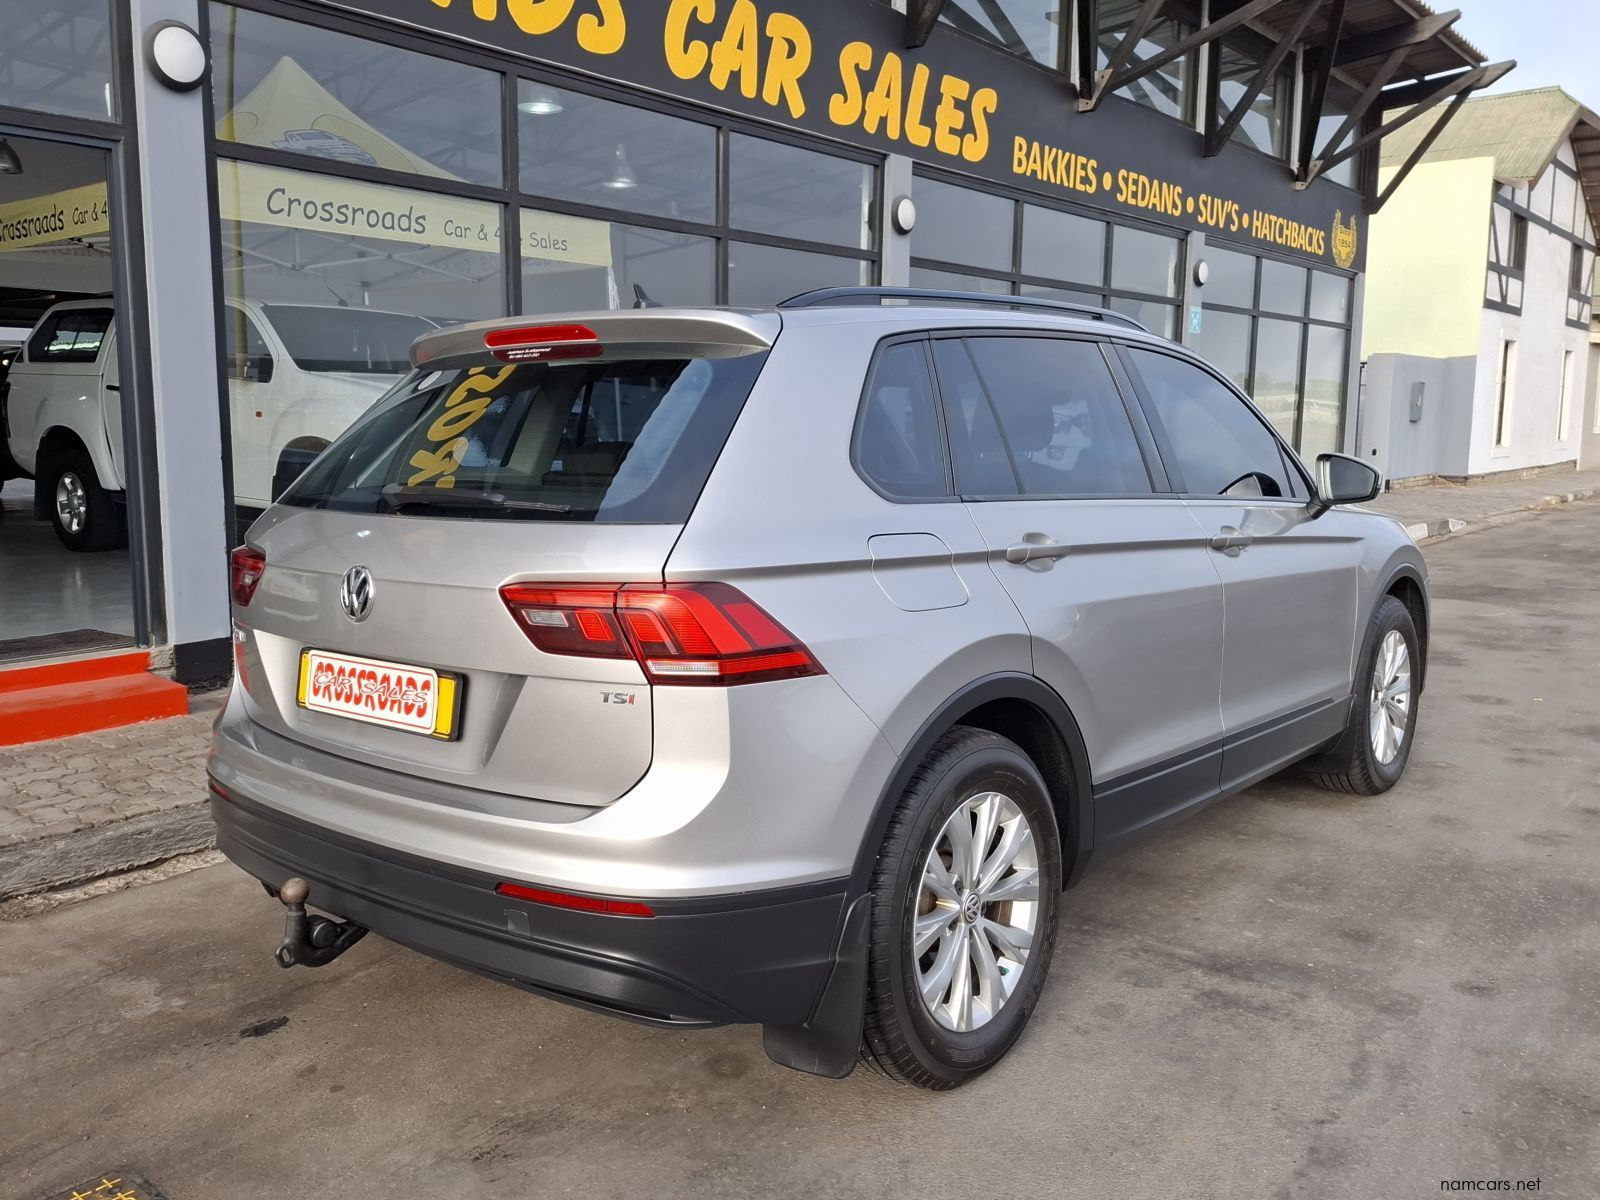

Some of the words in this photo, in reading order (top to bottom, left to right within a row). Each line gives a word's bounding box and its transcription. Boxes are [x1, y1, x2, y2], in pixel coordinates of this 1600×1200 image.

[664, 0, 812, 119] CAR
[828, 41, 998, 162] SALES
[72, 206, 88, 225] Car
[91, 202, 99, 221] &
[266, 187, 427, 235] Crossroads
[443, 219, 472, 239] Car
[477, 223, 489, 242] &
[529, 231, 568, 251] Sales
[1012, 135, 1098, 194] BAKKIES
[1116, 168, 1183, 217] SEDANS
[1197, 193, 1239, 232] SUV'S
[1252, 209, 1326, 256] HATCHBACKS
[312, 661, 432, 718] CROSSROADS
[315, 673, 351, 690] CAR
[361, 682, 428, 704] SALES
